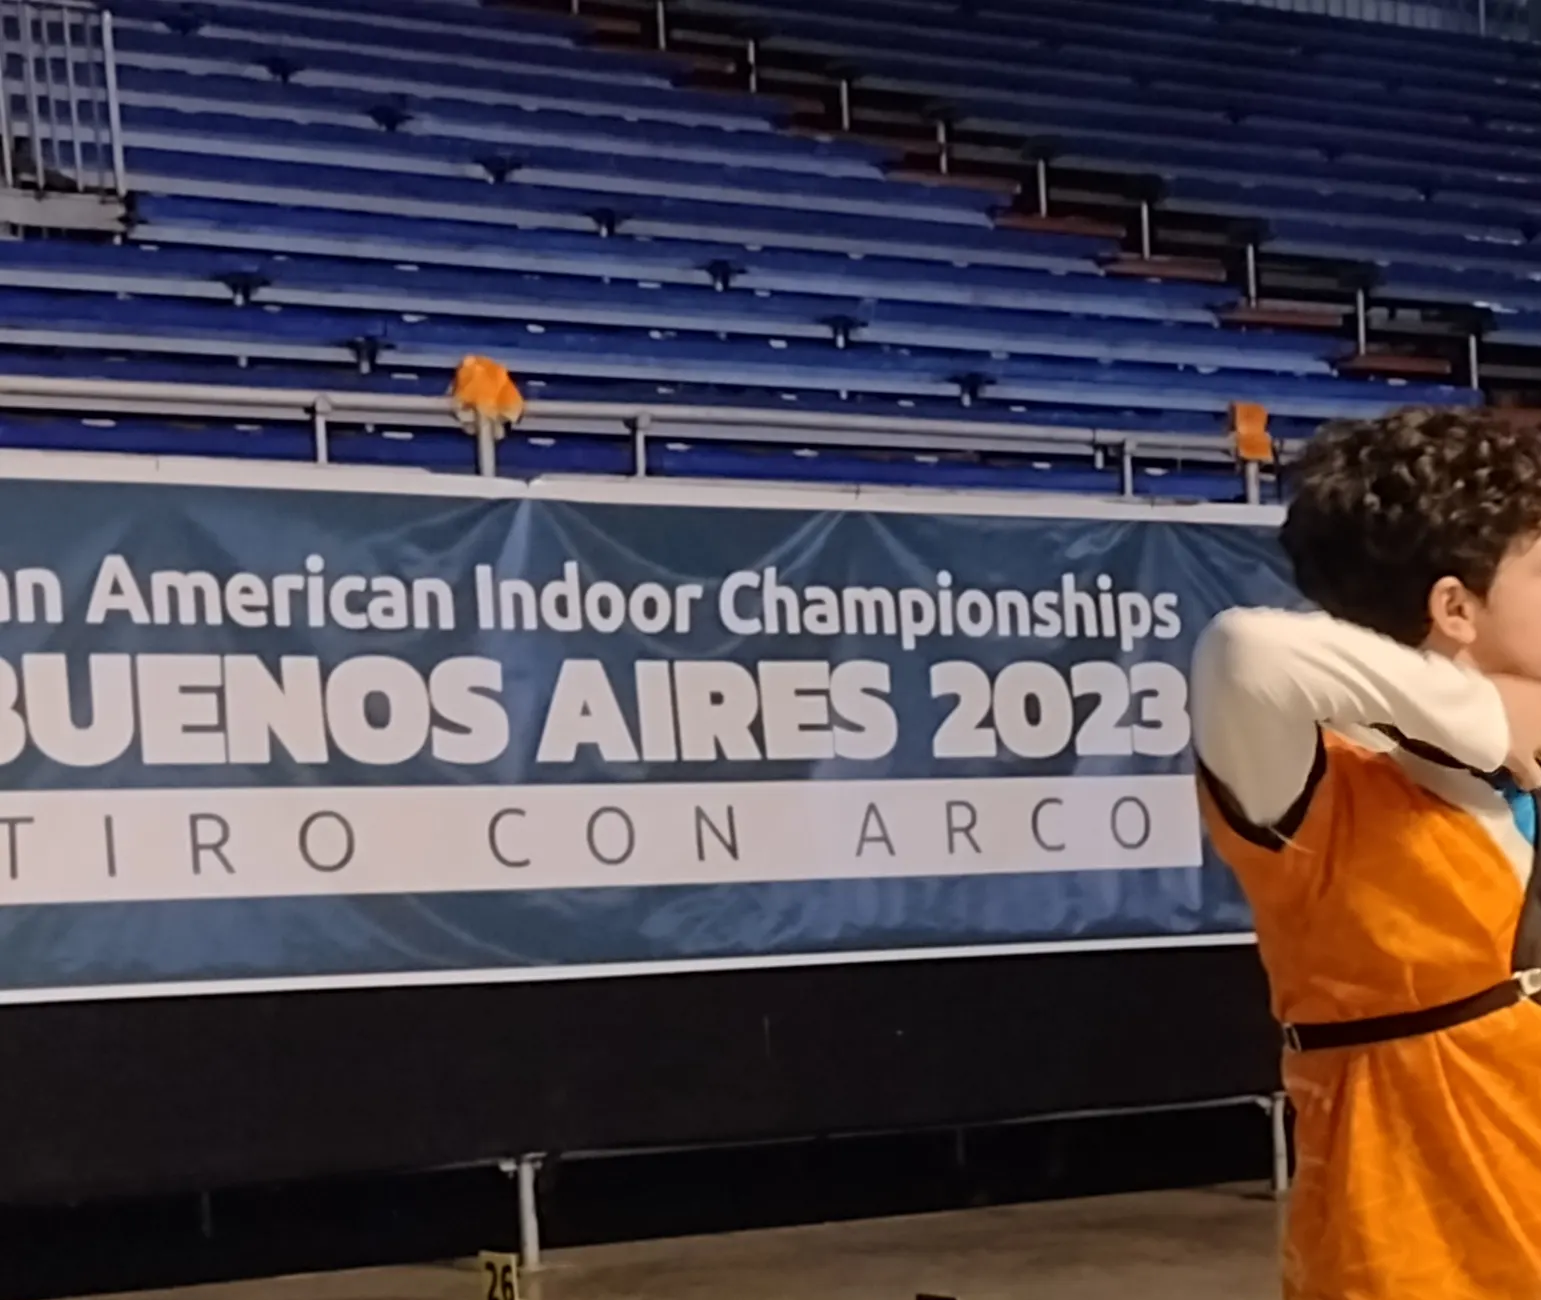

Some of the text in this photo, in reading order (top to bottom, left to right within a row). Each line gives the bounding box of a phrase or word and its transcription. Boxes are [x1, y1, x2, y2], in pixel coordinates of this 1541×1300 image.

[0, 554, 1182, 652] n American Indoor Championships
[0, 653, 1192, 767] UENOS AIRES 2023
[0, 796, 1151, 880] TIRO CON ARCO
